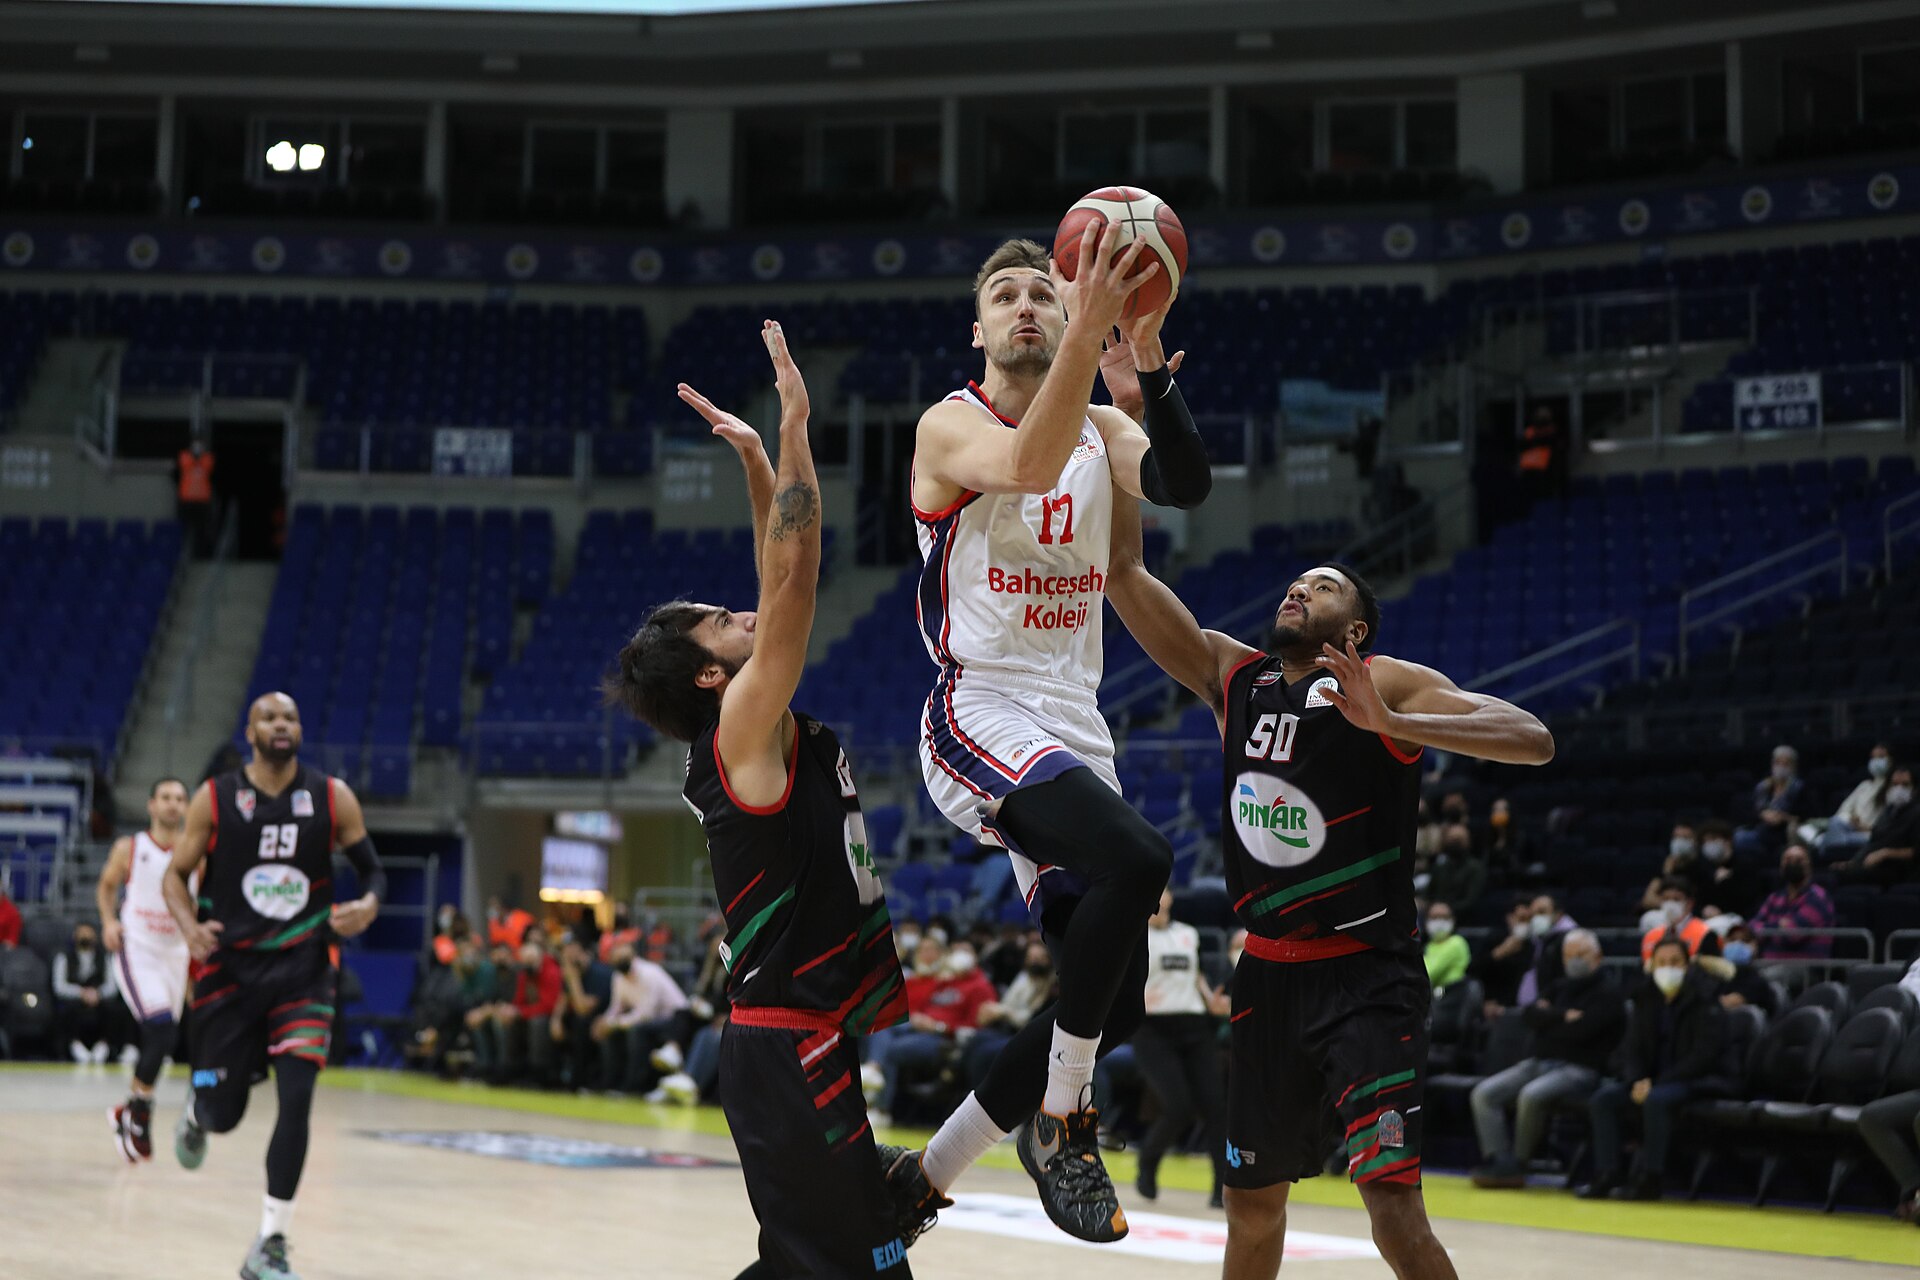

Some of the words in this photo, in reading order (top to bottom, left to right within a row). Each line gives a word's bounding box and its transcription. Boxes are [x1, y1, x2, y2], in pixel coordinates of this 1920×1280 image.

[1038, 493, 1073, 545] 17
[1023, 601, 1088, 635] Koleji
[1245, 713, 1301, 762] 50
[1239, 801, 1307, 830] PINAR
[259, 824, 298, 858] 29
[872, 1237, 907, 1271] ELTA
